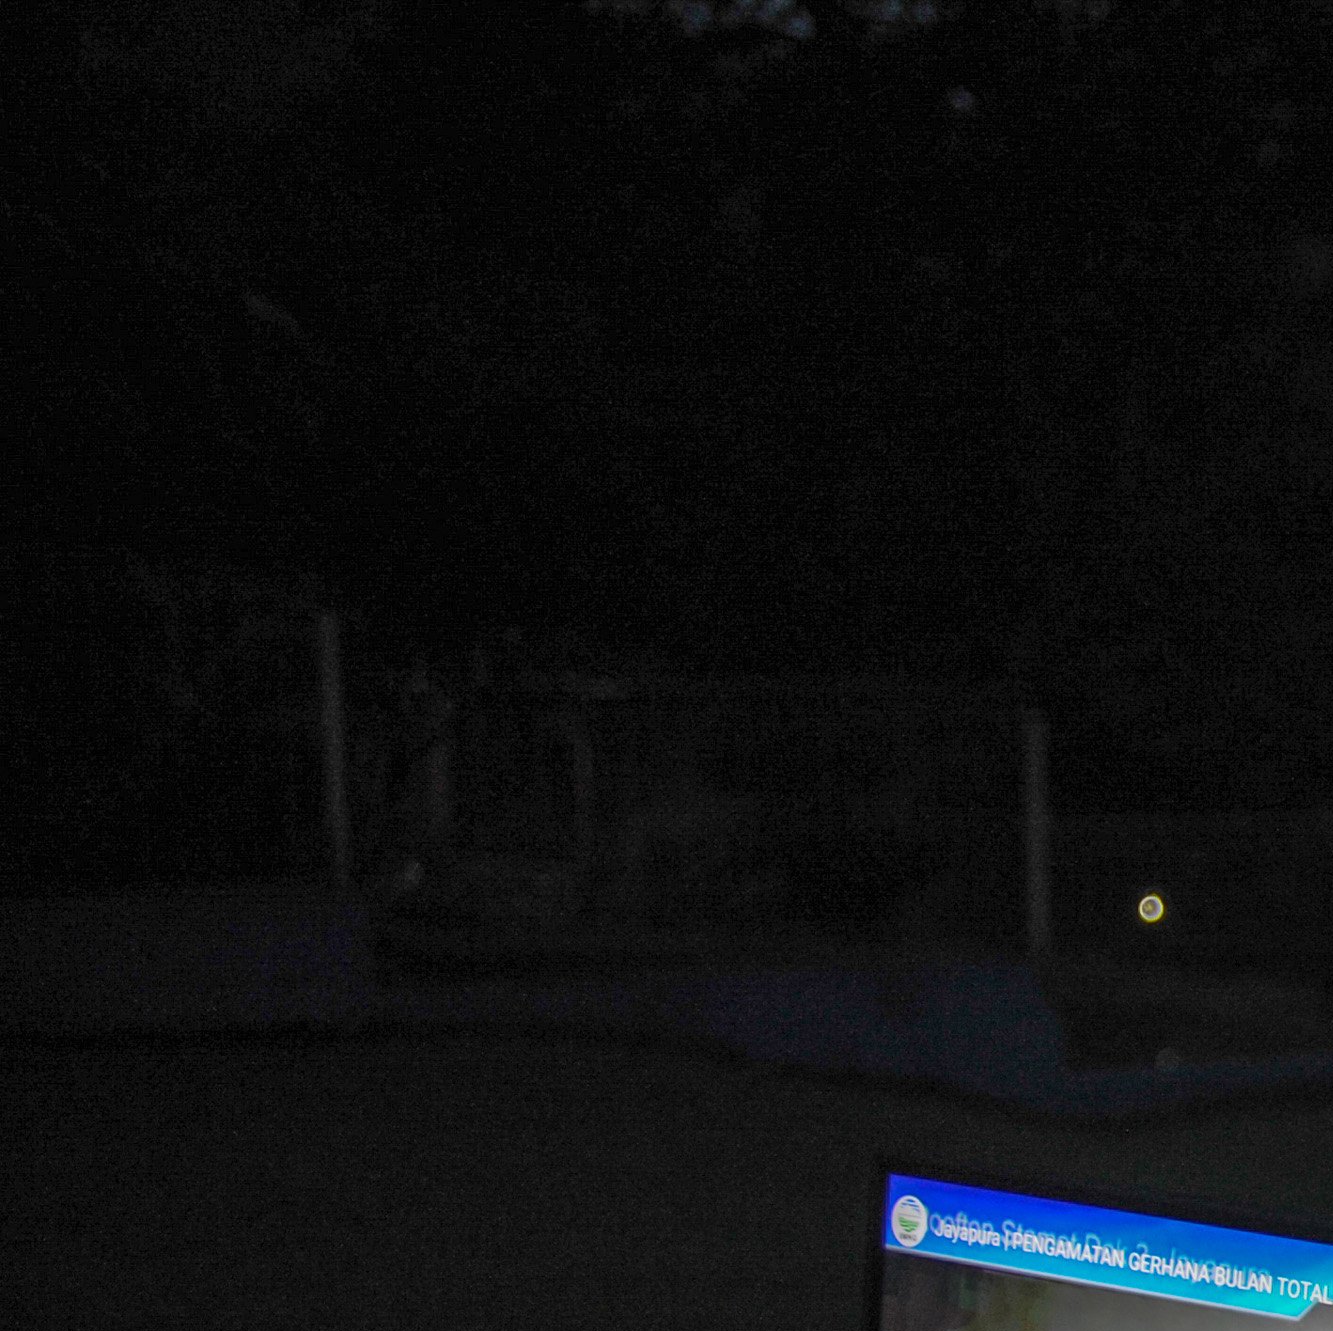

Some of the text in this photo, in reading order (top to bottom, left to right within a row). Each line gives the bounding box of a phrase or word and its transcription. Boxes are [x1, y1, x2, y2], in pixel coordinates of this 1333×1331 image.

[935, 1220, 1000, 1248] Jayapura
[1013, 1231, 1125, 1268] PENGAMATAN
[1128, 1252, 1210, 1283] GERHANA
[1214, 1267, 1272, 1294] BULAN
[1277, 1276, 1333, 1306] TOTAL
